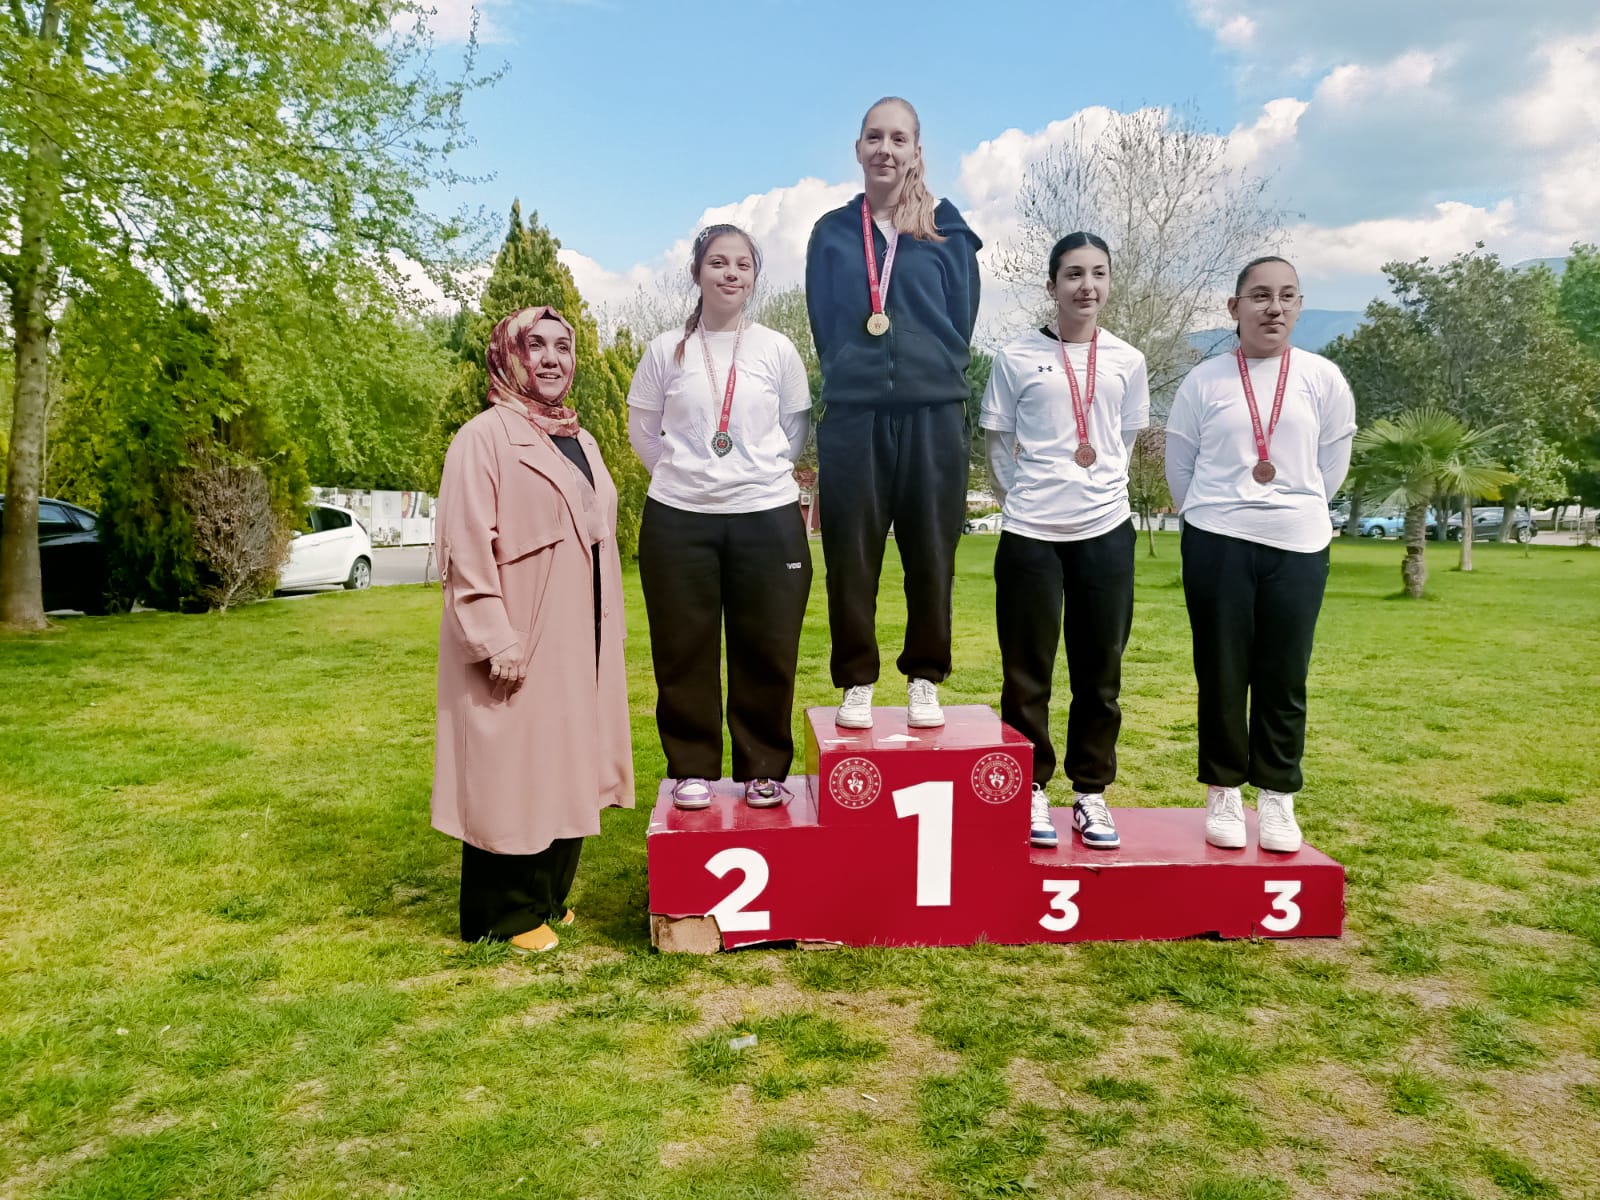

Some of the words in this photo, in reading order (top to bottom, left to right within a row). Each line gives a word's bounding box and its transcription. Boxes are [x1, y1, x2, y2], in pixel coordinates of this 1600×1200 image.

[892, 781, 954, 907] 1
[704, 847, 770, 932] 2
[1038, 880, 1080, 932] 3
[1261, 880, 1302, 932] 3
